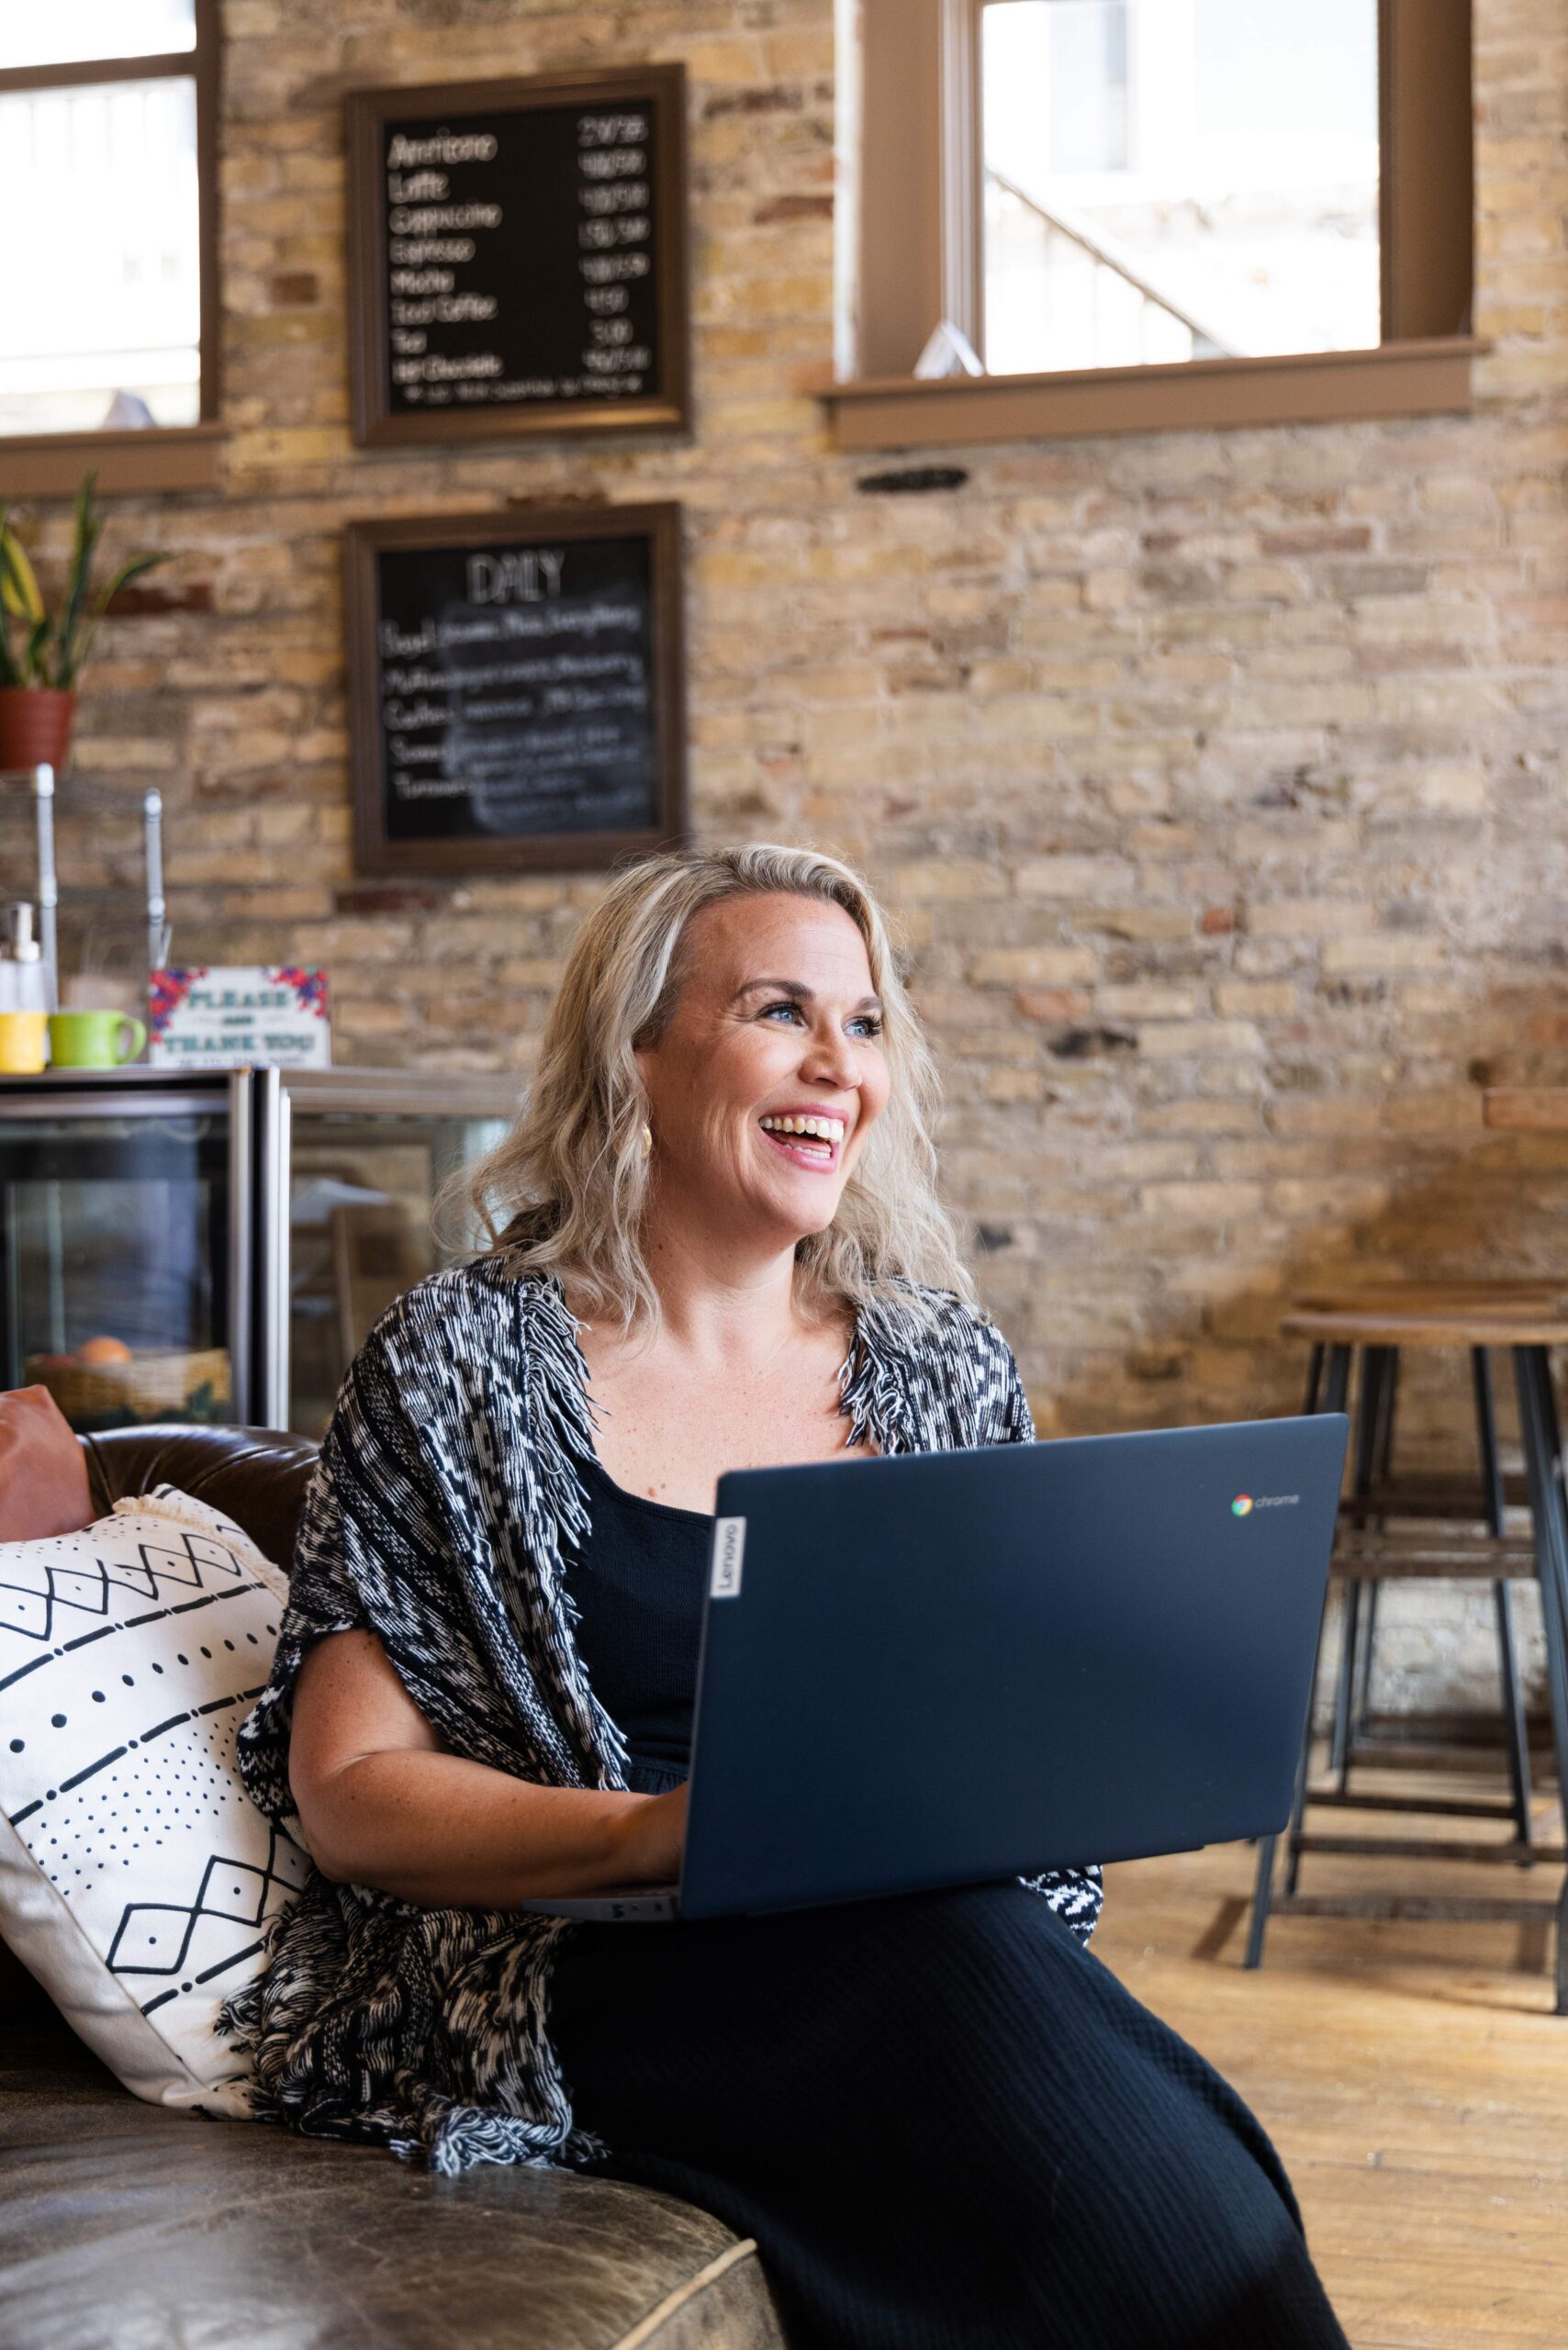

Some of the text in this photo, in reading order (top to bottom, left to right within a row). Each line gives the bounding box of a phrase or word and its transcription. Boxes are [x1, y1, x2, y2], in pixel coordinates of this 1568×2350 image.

[188, 990, 287, 1008] PLEASE
[165, 1033, 315, 1053] THANK YOU
[1254, 1494, 1300, 1508] chrome
[718, 1524, 738, 1589] Lenovo
